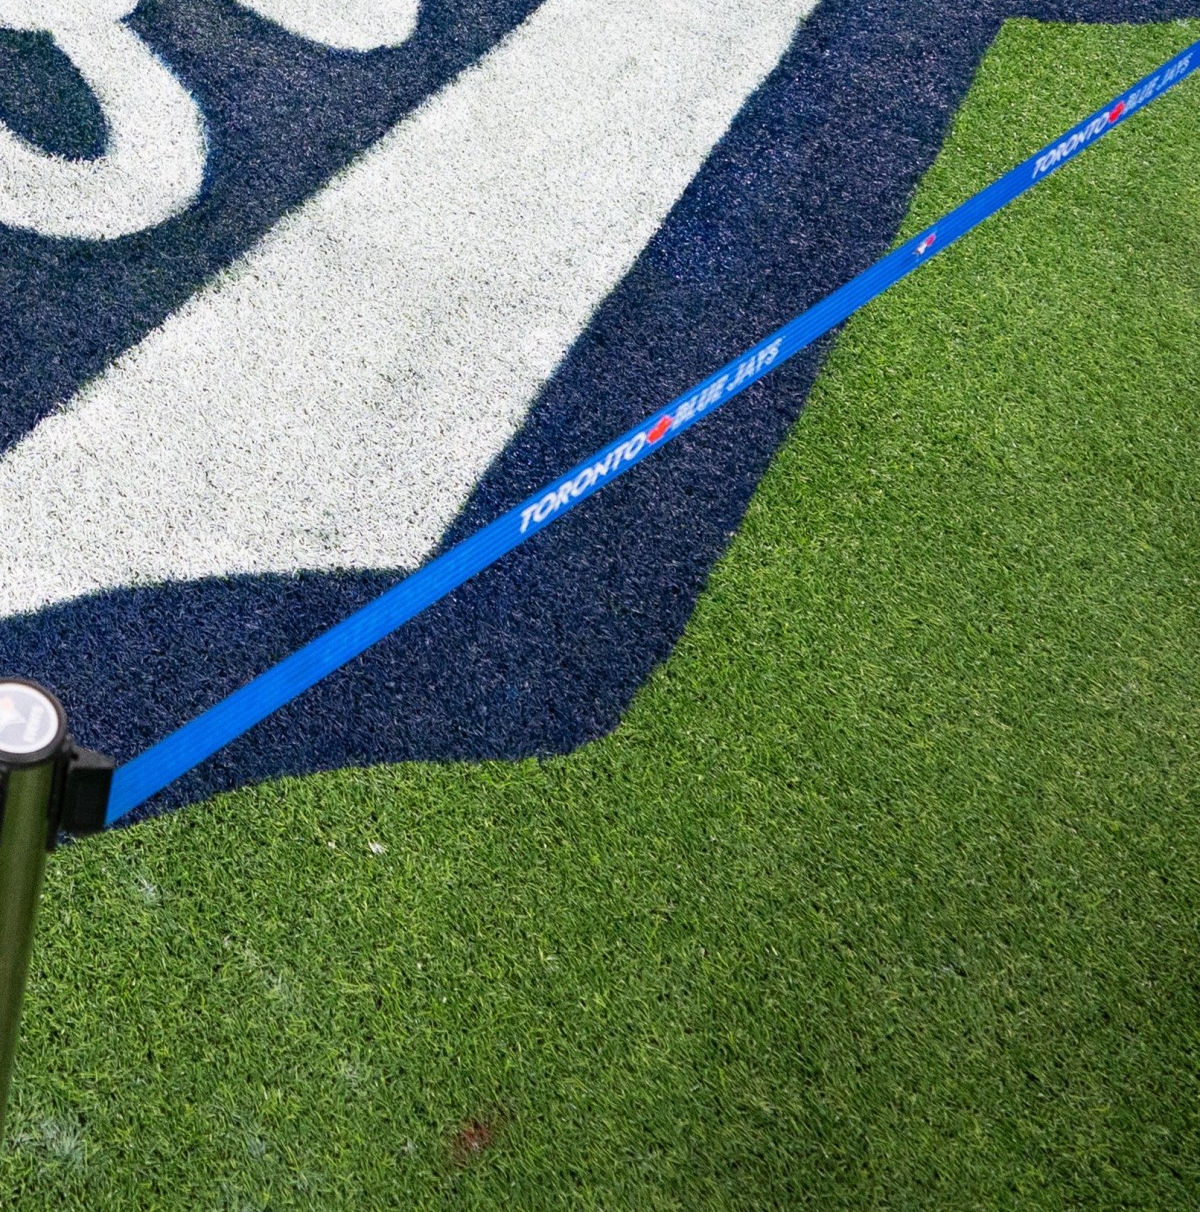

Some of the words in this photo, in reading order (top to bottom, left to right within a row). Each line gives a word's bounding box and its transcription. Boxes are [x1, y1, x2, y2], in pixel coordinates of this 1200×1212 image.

[1032, 111, 1110, 178] TORONTO
[1123, 75, 1161, 115] BLUE
[1153, 52, 1194, 89] JAYS
[519, 431, 647, 533] TORONTO
[671, 374, 729, 430] BLUE
[727, 336, 786, 391] JAYS
